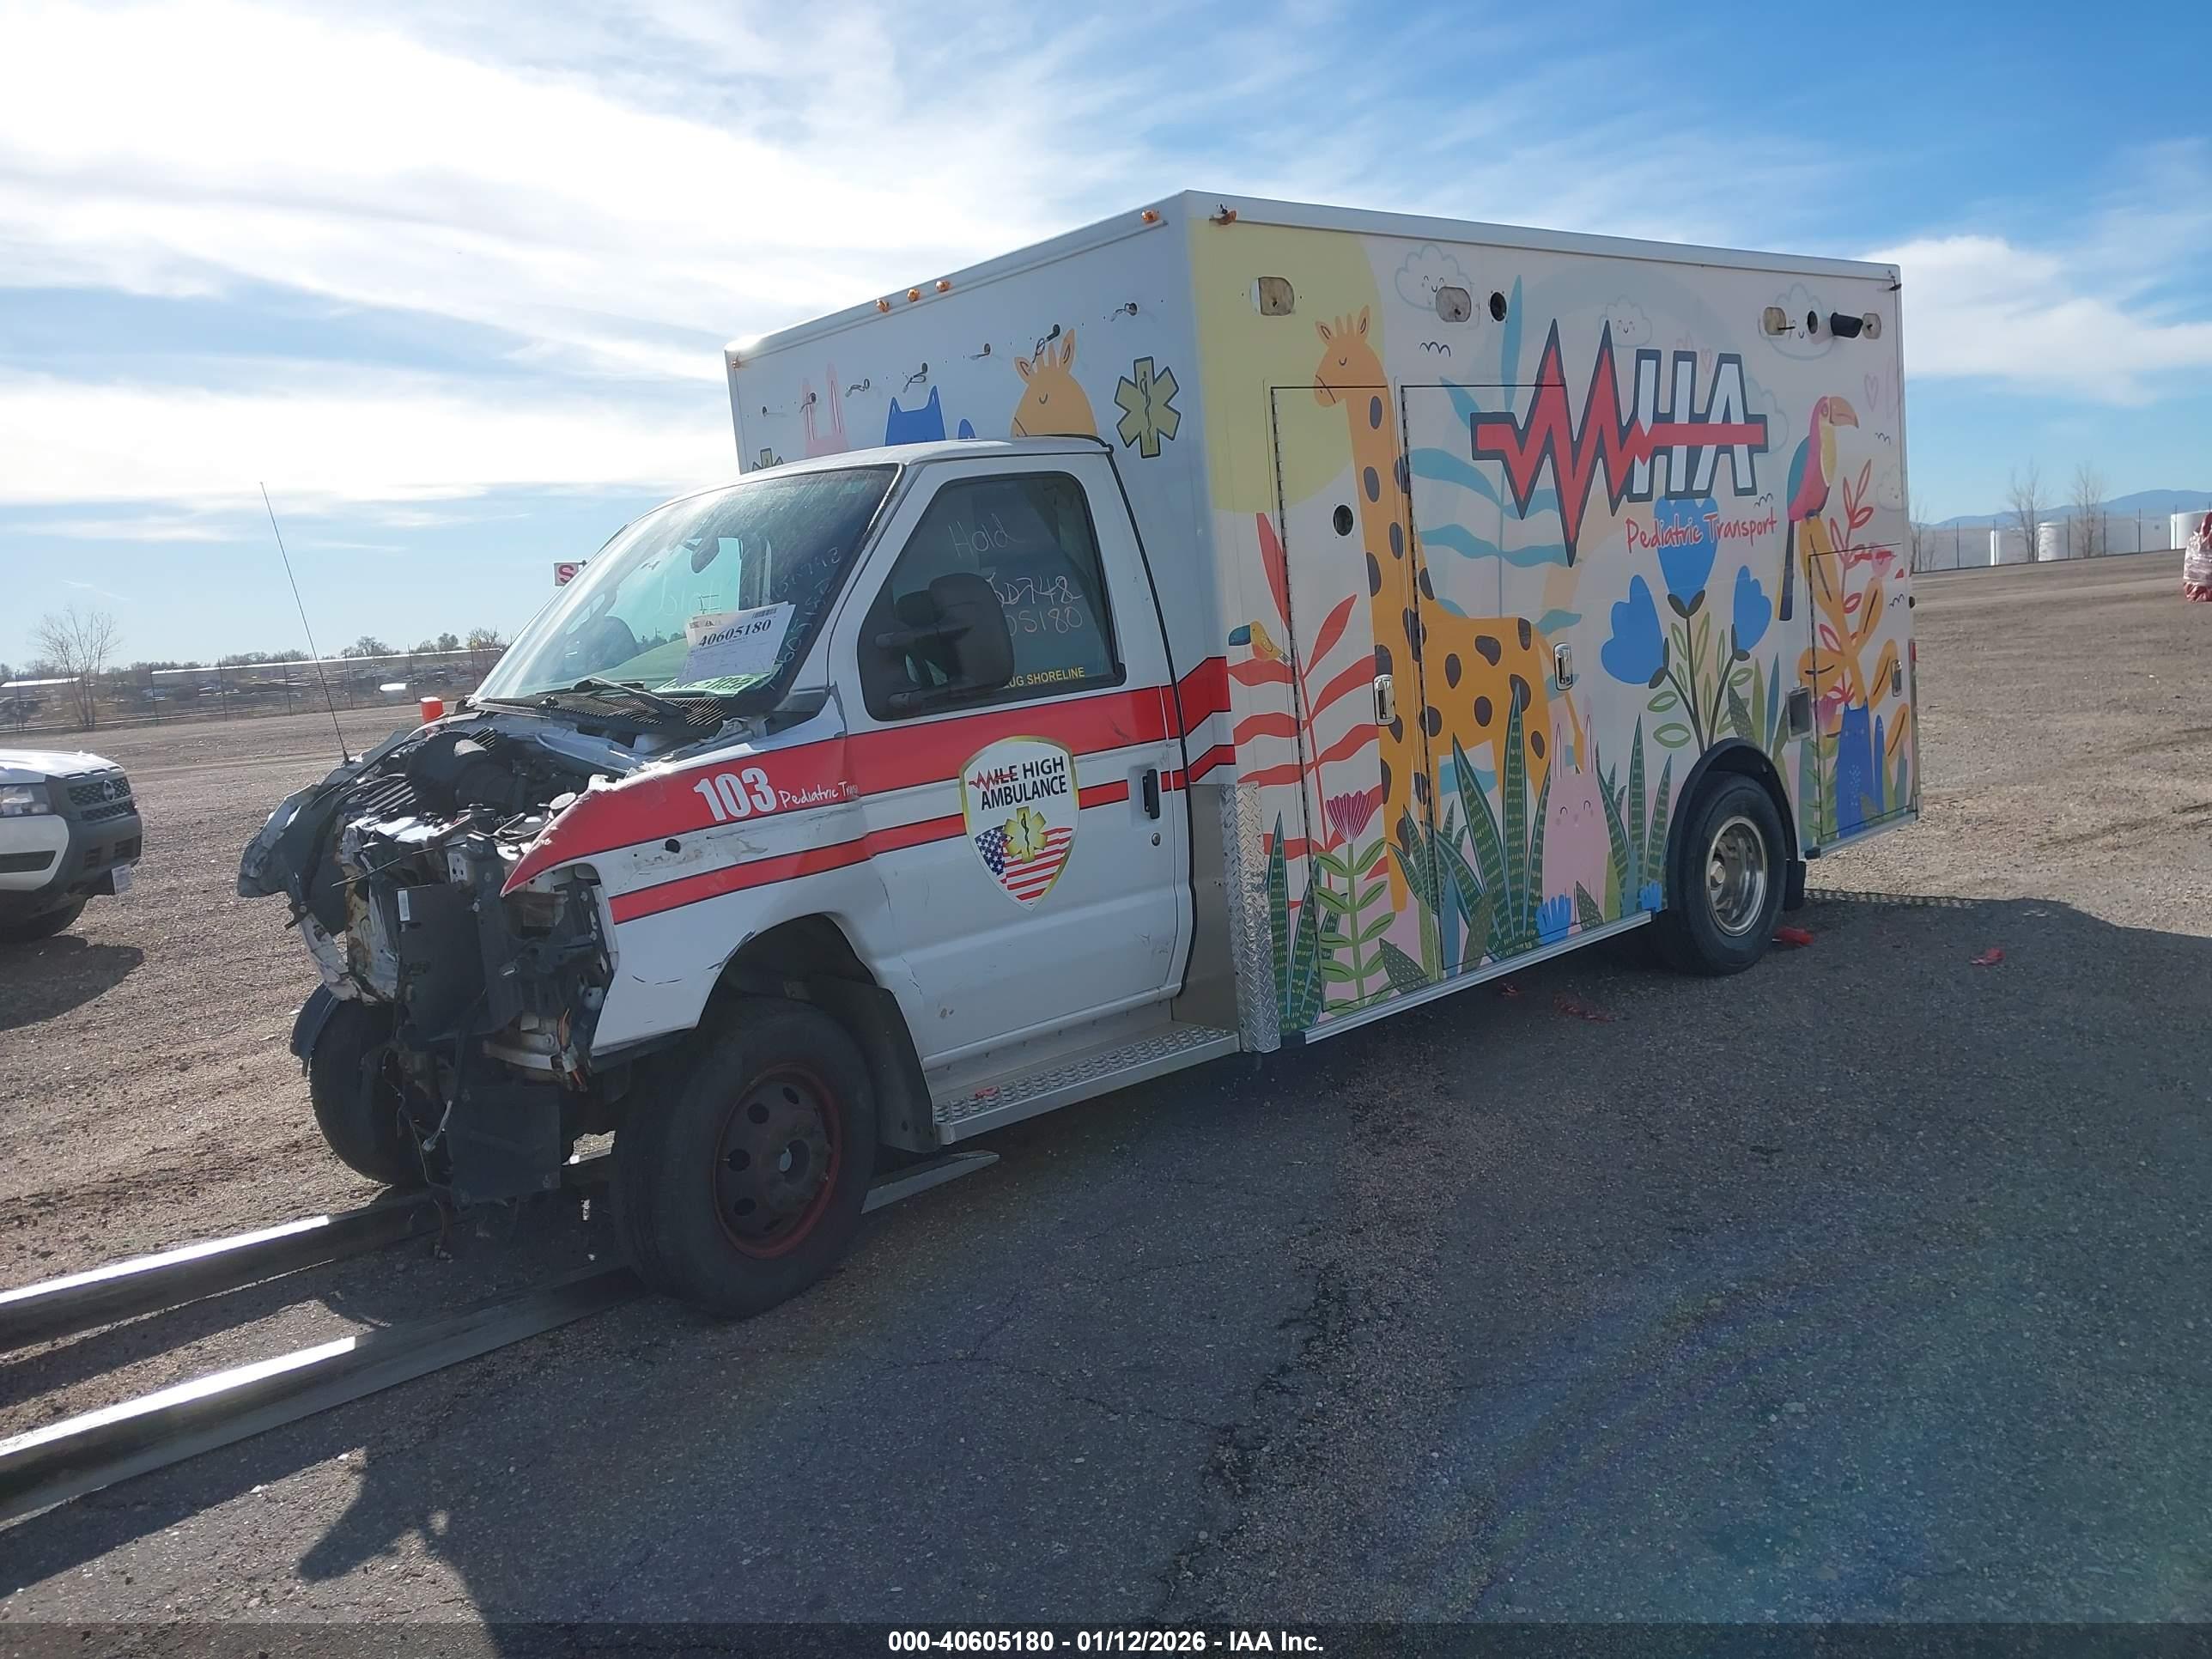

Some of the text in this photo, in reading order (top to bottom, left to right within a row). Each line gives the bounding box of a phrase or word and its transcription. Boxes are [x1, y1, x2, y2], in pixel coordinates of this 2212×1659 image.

[1626, 507, 1778, 553] Pediatric Transport
[699, 619, 772, 647] 40605180
[1027, 667, 1085, 684] SHORELINE
[1022, 756, 1065, 780] HIGH
[693, 768, 777, 822] 103
[778, 784, 838, 808] Pediatric
[981, 775, 1067, 811] AMBULANCE
